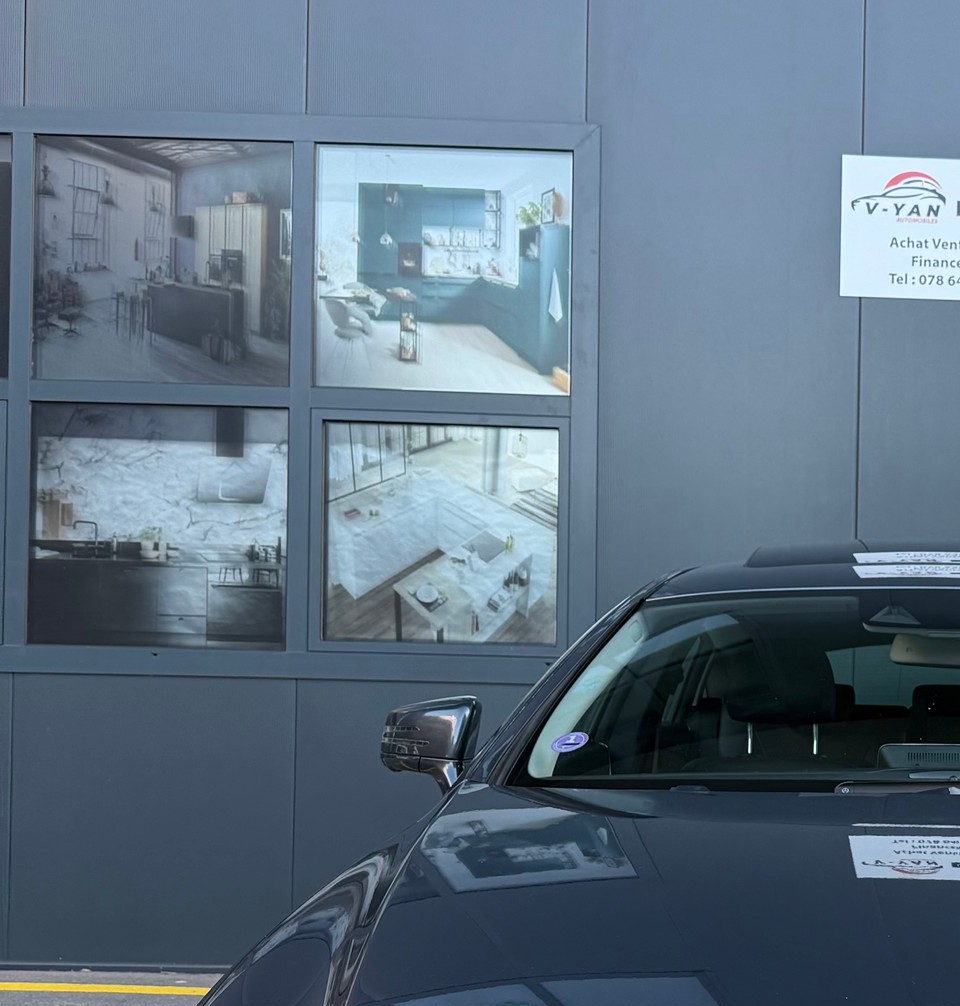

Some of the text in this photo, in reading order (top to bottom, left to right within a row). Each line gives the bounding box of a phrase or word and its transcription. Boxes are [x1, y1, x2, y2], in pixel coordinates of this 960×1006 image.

[866, 202, 941, 217] V-YAN
[896, 217, 938, 225] AUTOMOBILES
[890, 237, 929, 249] Achat
[919, 275, 944, 286] 078
